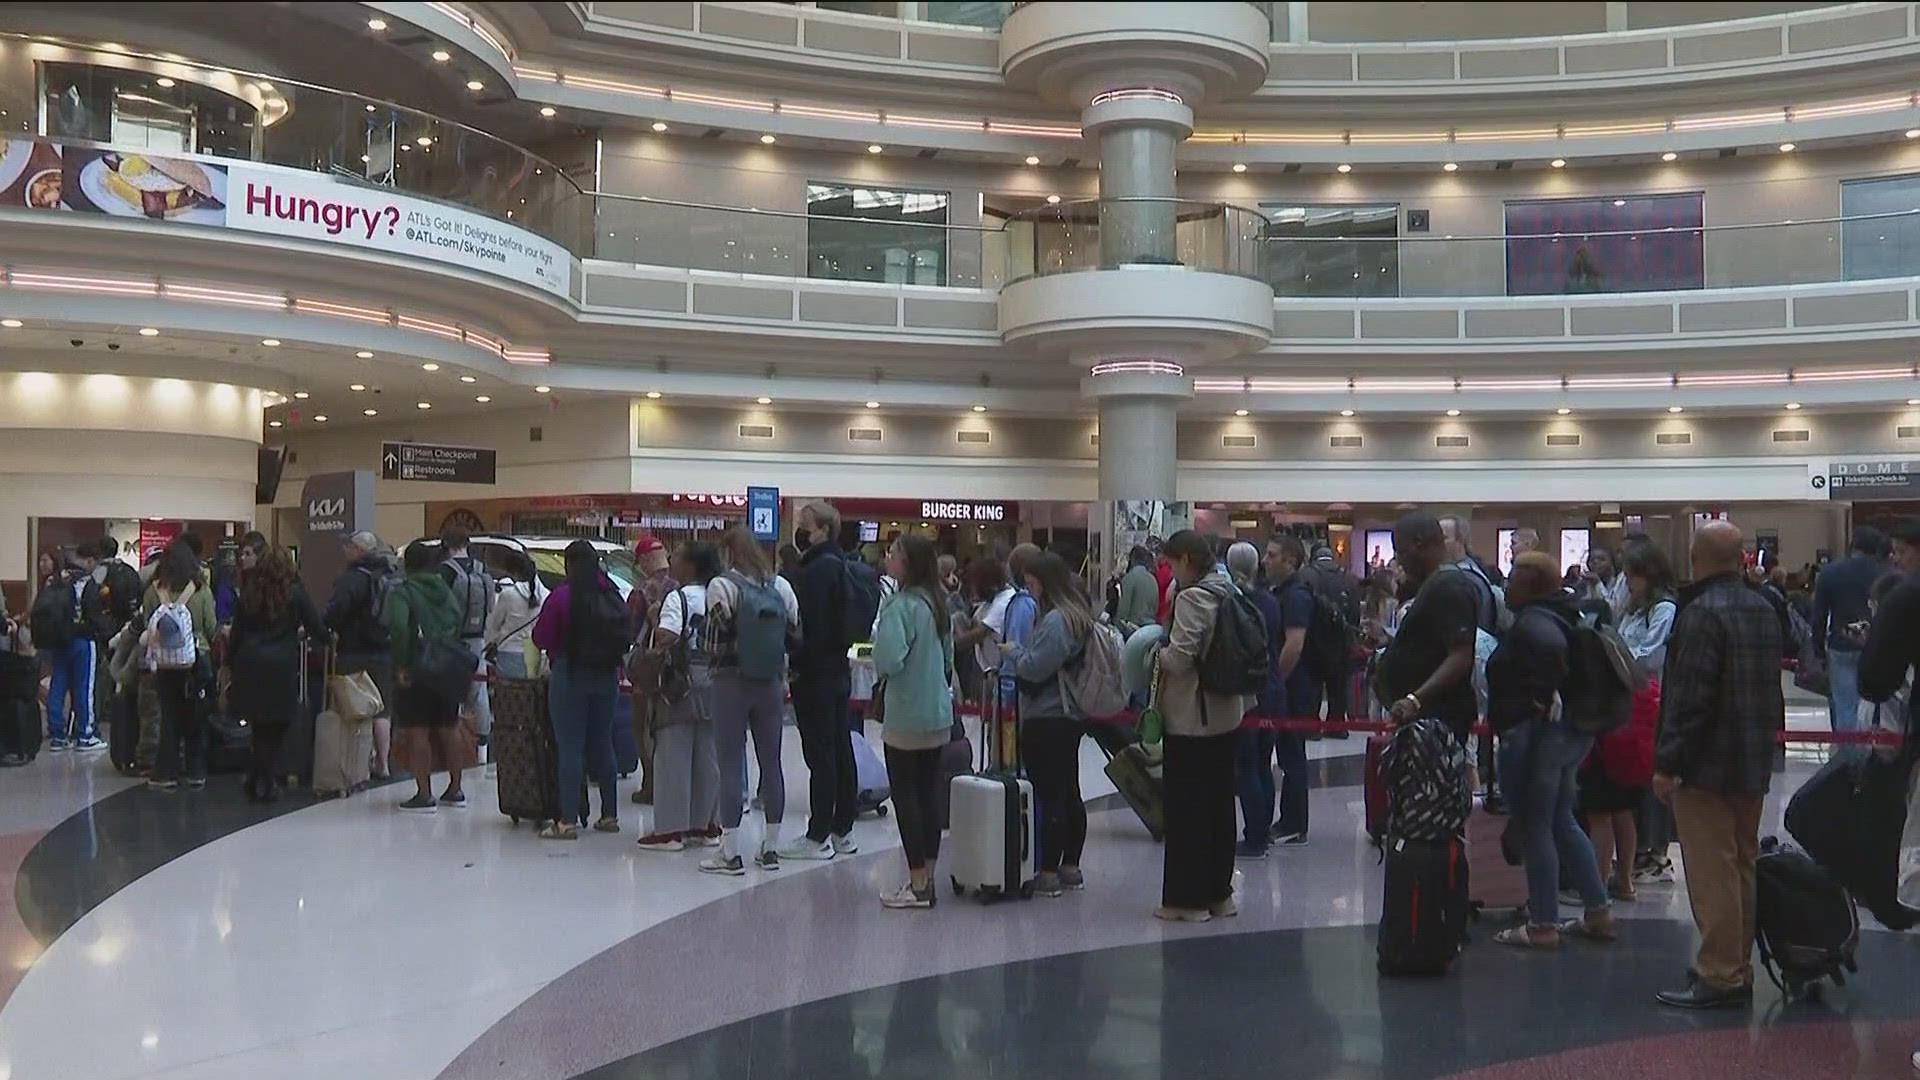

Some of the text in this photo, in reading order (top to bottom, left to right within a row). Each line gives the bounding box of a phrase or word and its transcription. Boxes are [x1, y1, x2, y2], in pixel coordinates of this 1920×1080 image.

[247, 183, 400, 239] Hungry?
[405, 227, 506, 263] @ATL.com/Skypointe
[407, 211, 431, 227] ATL's
[434, 217, 453, 232] Got
[464, 225, 498, 246] Delights
[498, 234, 523, 253] before
[524, 245, 540, 259] your
[415, 448, 433, 458] Main
[434, 449, 477, 461] Checkpoint
[415, 464, 456, 475] Restrooms
[309, 498, 344, 518] KIA
[922, 502, 1004, 521] BURGER KING
